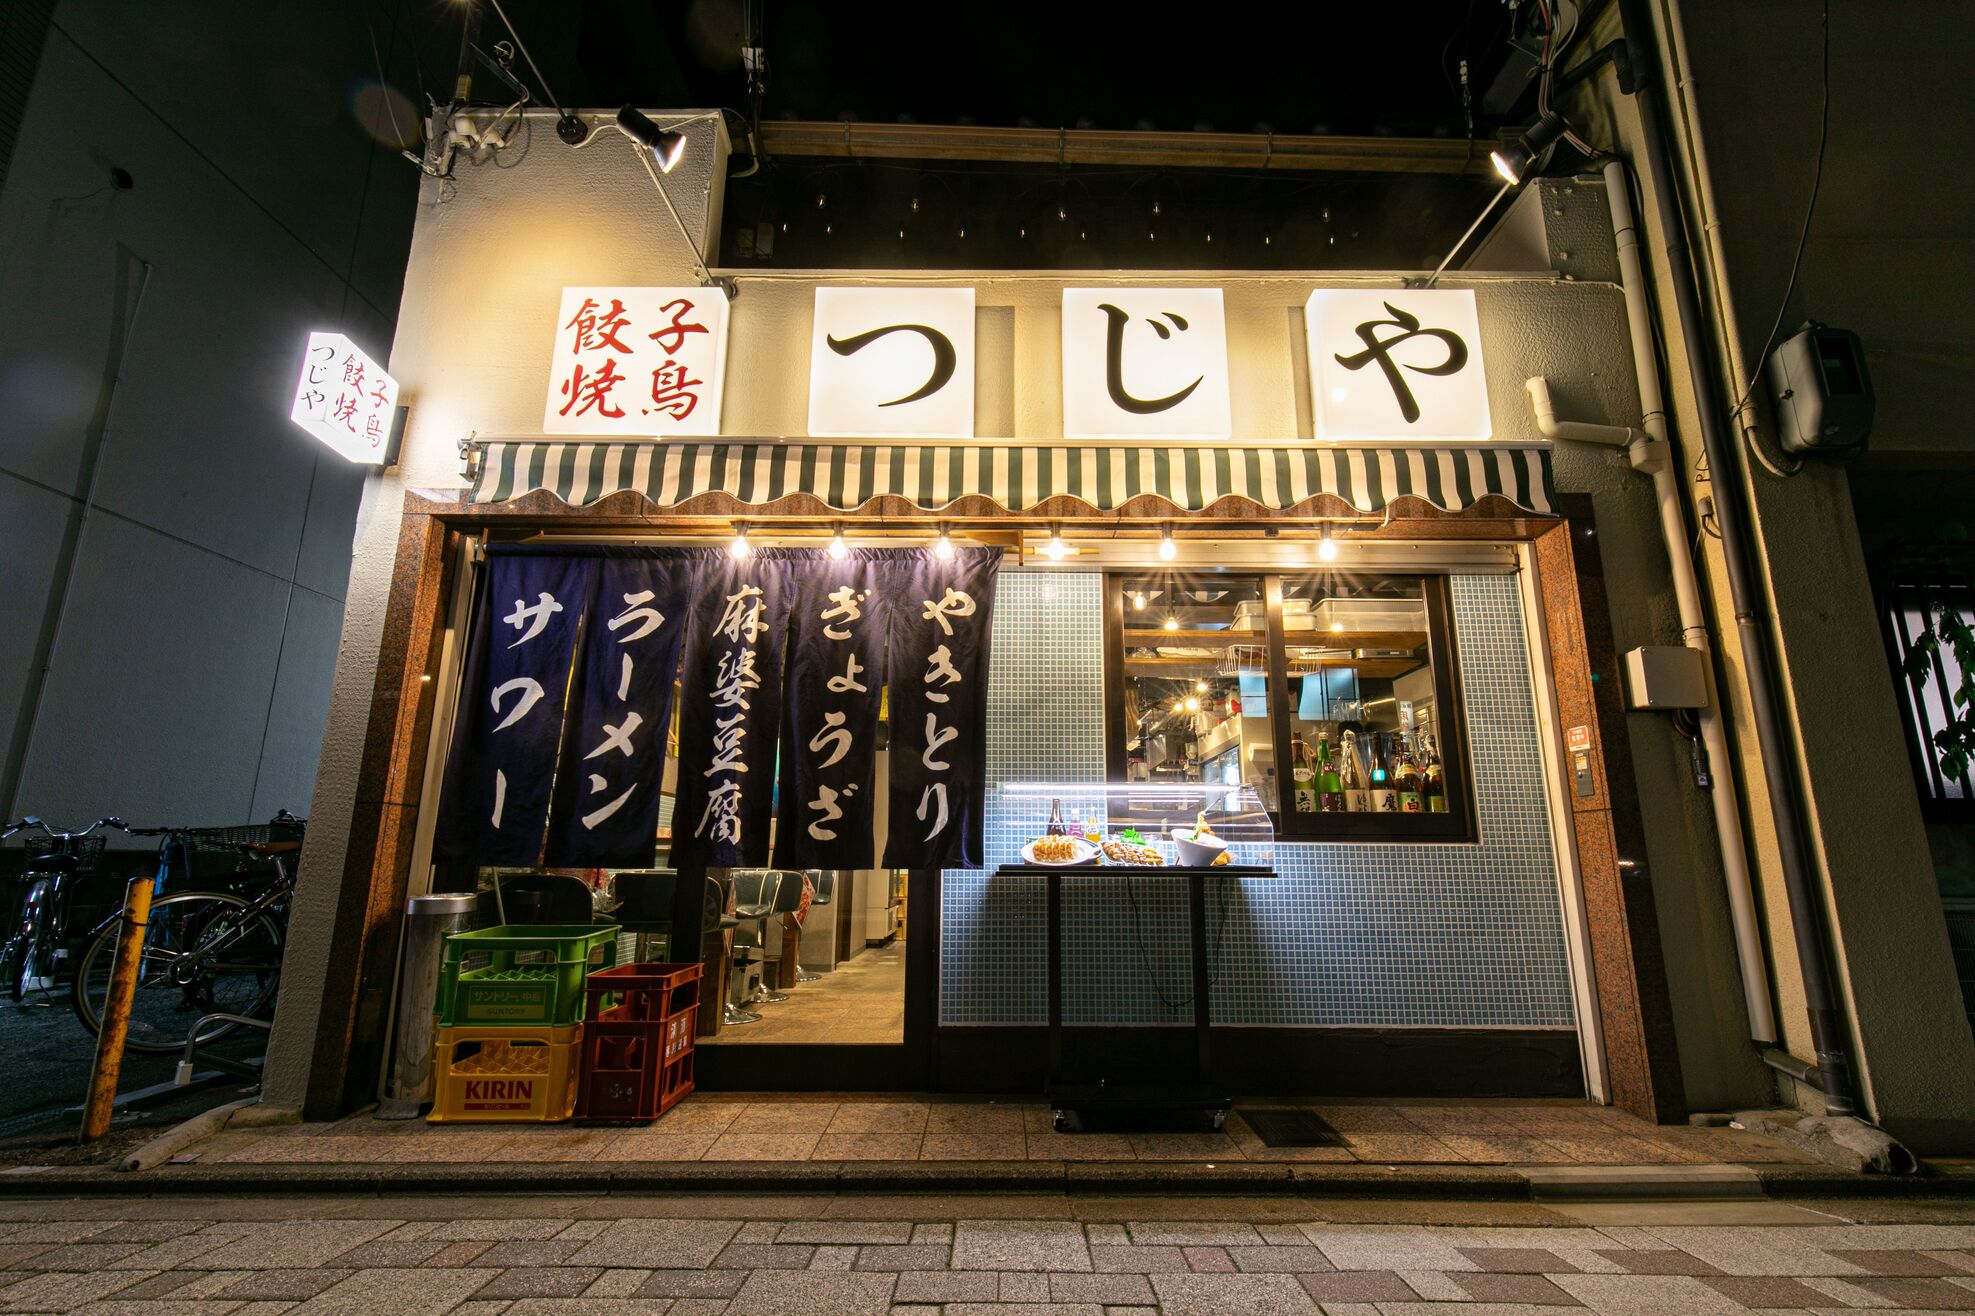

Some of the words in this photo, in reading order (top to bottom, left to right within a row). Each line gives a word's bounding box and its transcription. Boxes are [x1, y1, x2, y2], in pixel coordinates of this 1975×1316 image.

[565, 298, 709, 355] 餃子
[300, 346, 335, 410] つじや
[342, 353, 389, 408] 餃子
[559, 358, 703, 421] 焼鳥
[333, 392, 383, 448] 焼鳥
[490, 592, 563, 829] サワー
[582, 589, 666, 830] ラーメン
[694, 584, 769, 845] 麻婆豆腐
[807, 586, 871, 841] ぎょうざ
[916, 587, 976, 842] やきとり
[465, 1080, 532, 1100] KIRIN
